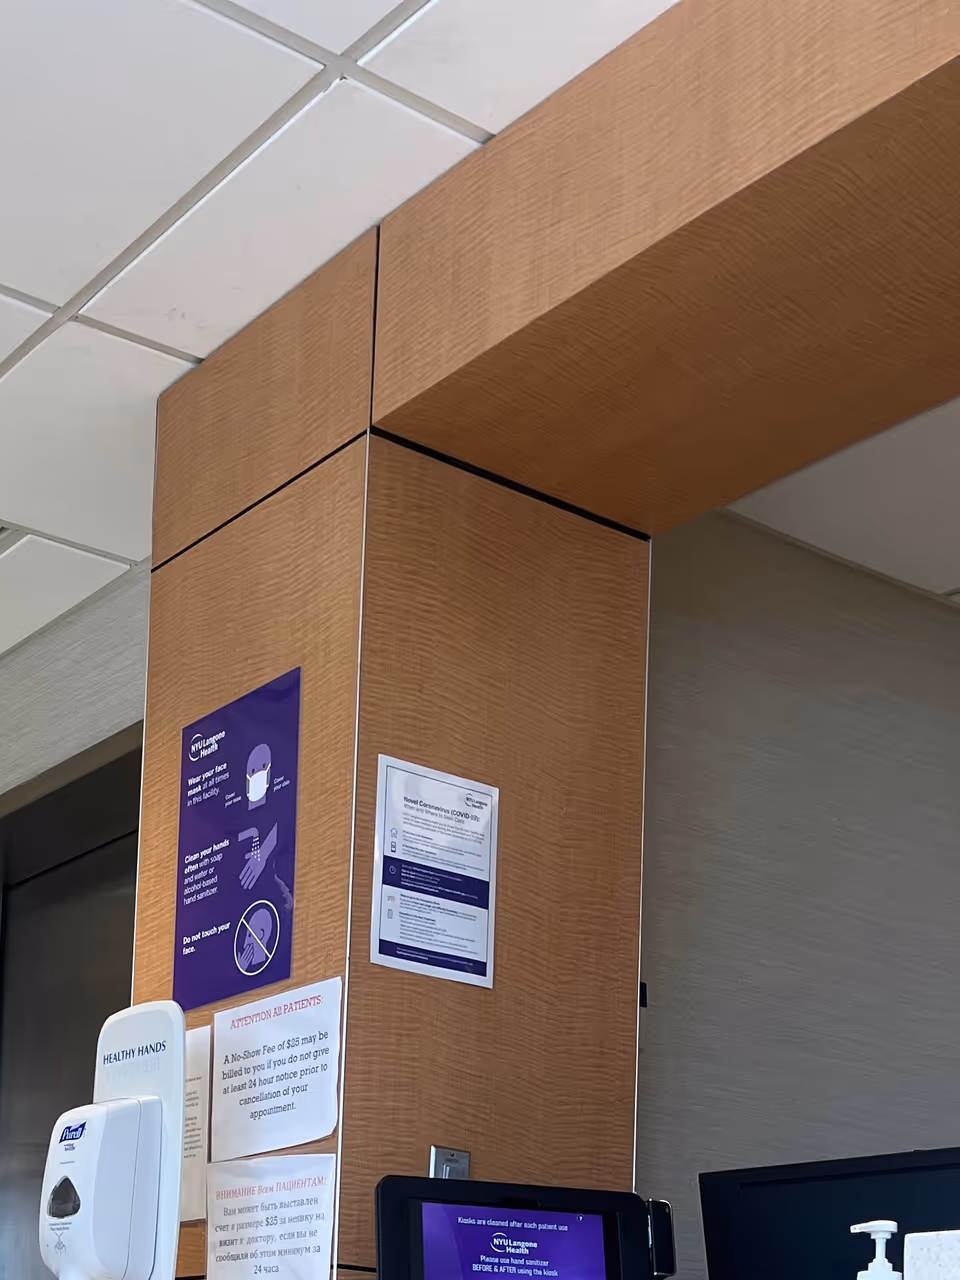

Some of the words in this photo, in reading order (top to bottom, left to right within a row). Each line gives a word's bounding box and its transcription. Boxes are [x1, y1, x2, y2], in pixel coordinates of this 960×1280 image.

[191, 740, 203, 753] NYU
[203, 730, 226, 746] Langone
[200, 742, 218, 758] Health
[188, 775, 201, 786] Wear
[202, 769, 214, 782] your
[215, 762, 227, 773] face
[187, 785, 202, 797] mask
[203, 781, 208, 790] at
[215, 772, 230, 784] times
[192, 795, 202, 805] this
[403, 796, 418, 805] Novel
[419, 800, 450, 814] Coronavirus
[185, 853, 199, 864] Clean
[200, 847, 212, 859] your
[213, 839, 230, 851] hands
[184, 863, 198, 874] often
[199, 858, 210, 868] with
[210, 853, 223, 863] soap
[184, 874, 194, 885] and
[194, 869, 208, 880] water
[184, 894, 196, 905] hand
[183, 936, 191, 945] Do
[191, 932, 201, 942] not
[202, 926, 217, 938] touch
[217, 922, 231, 934] your
[230, 1009, 272, 1030] ATTENTION
[273, 1006, 283, 1018] All
[283, 995, 324, 1014] PATIENTS:
[103, 1047, 136, 1065] HEALTHY
[137, 1040, 167, 1057] HANDS
[223, 1055, 230, 1065] A
[231, 1048, 261, 1063] No-Show
[262, 1044, 276, 1055] Fee
[277, 1040, 285, 1051] of
[286, 1036, 300, 1050] $25
[300, 1033, 317, 1047] may
[318, 1030, 329, 1041] be
[222, 1067, 243, 1080] billed
[243, 1065, 251, 1075] to
[252, 1062, 265, 1076] you
[266, 1059, 272, 1070] if
[273, 1057, 286, 1071] you
[287, 1053, 298, 1064] do
[299, 1050, 312, 1062] not
[312, 1046, 330, 1060] give
[222, 1086, 230, 1095] at
[230, 1081, 247, 1094] least
[248, 1079, 257, 1089] 24
[258, 1076, 275, 1088] hour
[275, 1070, 298, 1084] notice
[299, 1065, 320, 1080] prior
[320, 1063, 328, 1072] to
[238, 1088, 281, 1106] cancellation
[282, 1086, 290, 1096] of
[291, 1083, 309, 1097] your
[249, 1102, 296, 1120] appointment.
[216, 1185, 256, 1201] ВНИМАНИЕ
[257, 1184, 274, 1195] Всем
[275, 1176, 327, 1192] ПАЦИЕНТАМ:
[223, 1206, 237, 1216] Вам
[237, 1204, 259, 1214] может
[260, 1201, 278, 1211] быть
[279, 1197, 319, 1209] выставлен
[214, 1224, 230, 1232] счет
[230, 1223, 235, 1231] в
[236, 1220, 264, 1232] размере
[264, 1215, 278, 1227] $25
[287, 1213, 314, 1224] неявку
[315, 1212, 325, 1221] на
[457, 1216, 476, 1225] Kiosks
[486, 1219, 509, 1227] cleaned
[509, 1220, 523, 1228] after
[538, 1223, 558, 1231] patient
[218, 1238, 238, 1247] визит
[279, 1231, 296, 1241] если
[296, 1230, 307, 1238] вы
[308, 1229, 318, 1238] не
[493, 1238, 508, 1246] NYU
[509, 1239, 538, 1248] Langone
[215, 1252, 248, 1263] сообщили
[249, 1249, 258, 1260] об
[259, 1250, 277, 1258] этом
[277, 1246, 311, 1257] минимум
[312, 1245, 321, 1254] за
[506, 1246, 529, 1254] Health
[253, 1264, 262, 1275] 24
[263, 1265, 279, 1273] часа
[472, 1263, 493, 1272] BEFORE
[499, 1266, 516, 1274] AFTER
[517, 1267, 533, 1276] using
[533, 1268, 542, 1276] the
[543, 1269, 559, 1277] kiosk
[480, 1255, 499, 1263] Please
[510, 1257, 525, 1265] hand
[525, 1259, 549, 1267] sanitizer
